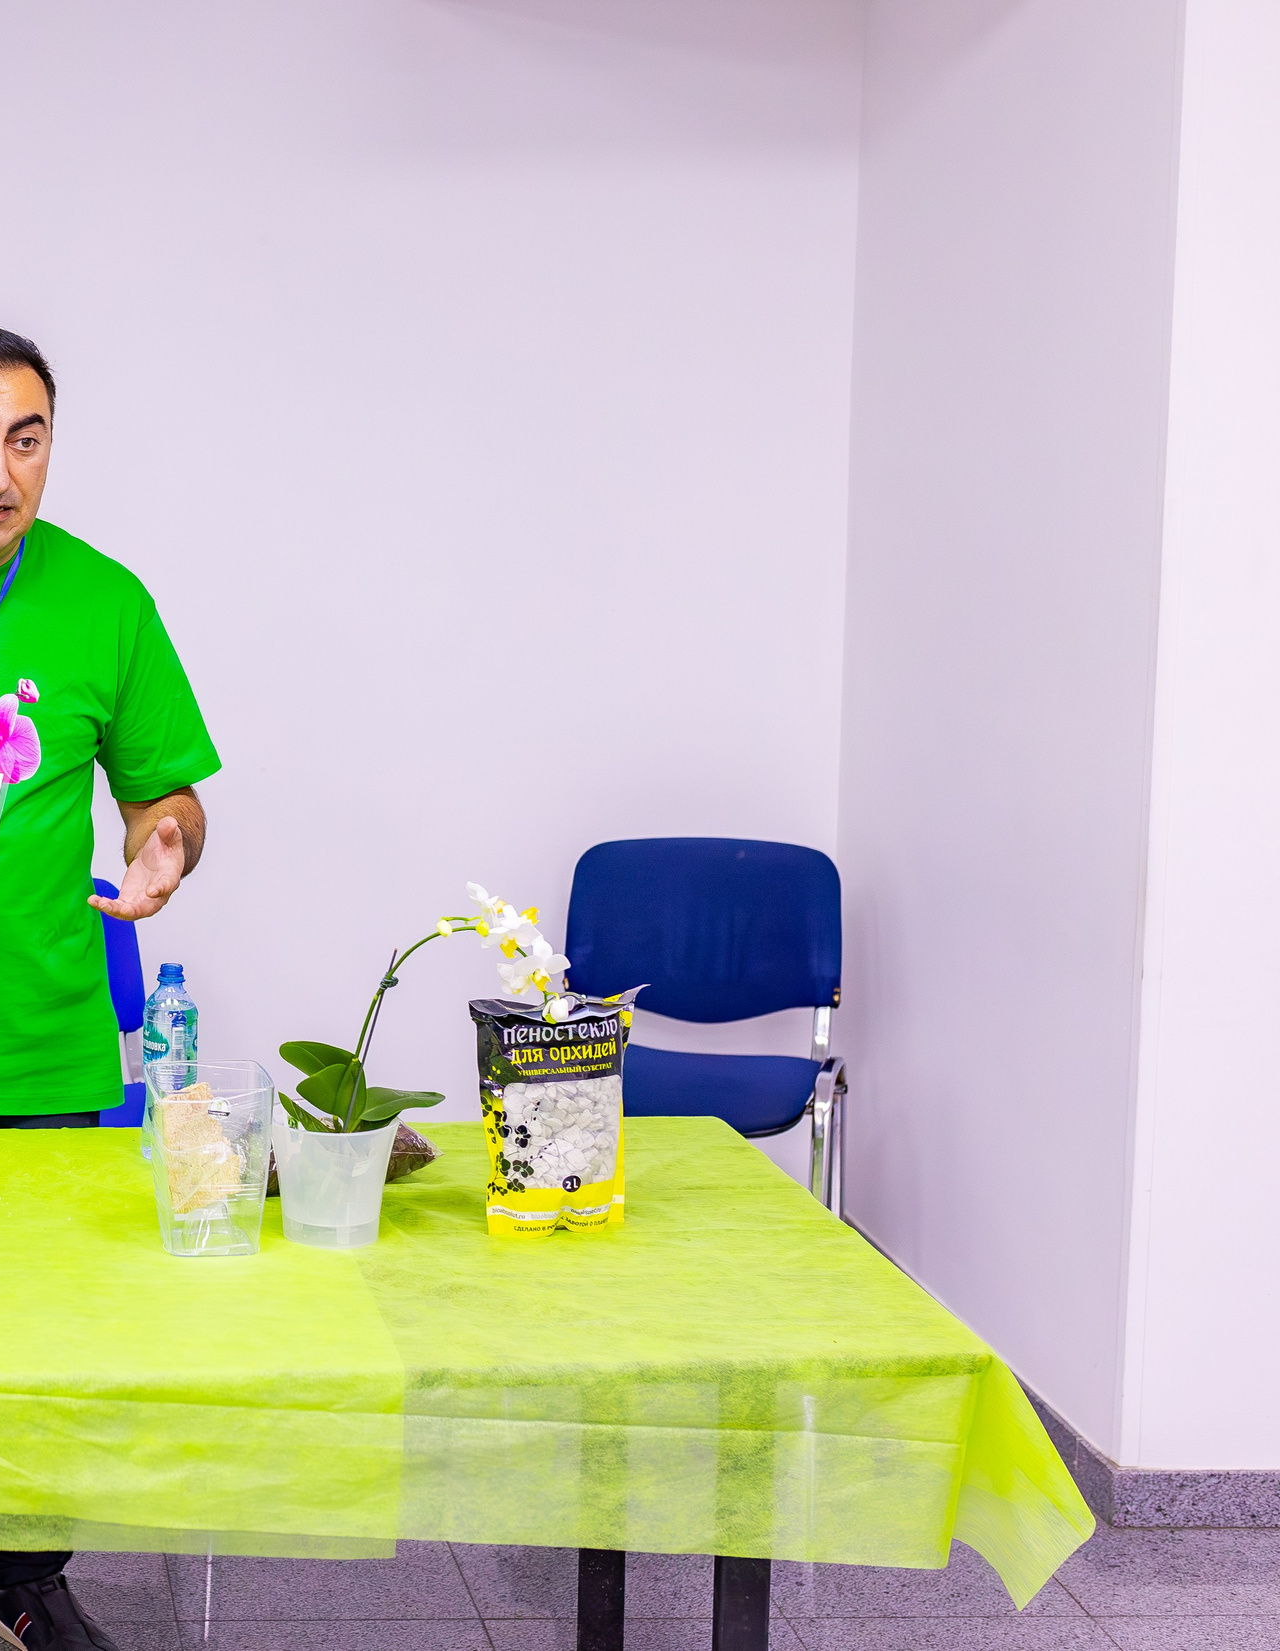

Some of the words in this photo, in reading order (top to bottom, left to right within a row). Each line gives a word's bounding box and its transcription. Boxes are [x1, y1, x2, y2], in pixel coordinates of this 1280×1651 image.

[510, 1048, 544, 1066] для
[549, 1038, 617, 1065] орхидей
[517, 1064, 582, 1076] УНИВЕРСАЛЬНЫЙ
[582, 1062, 613, 1073] СУБСТРАТ
